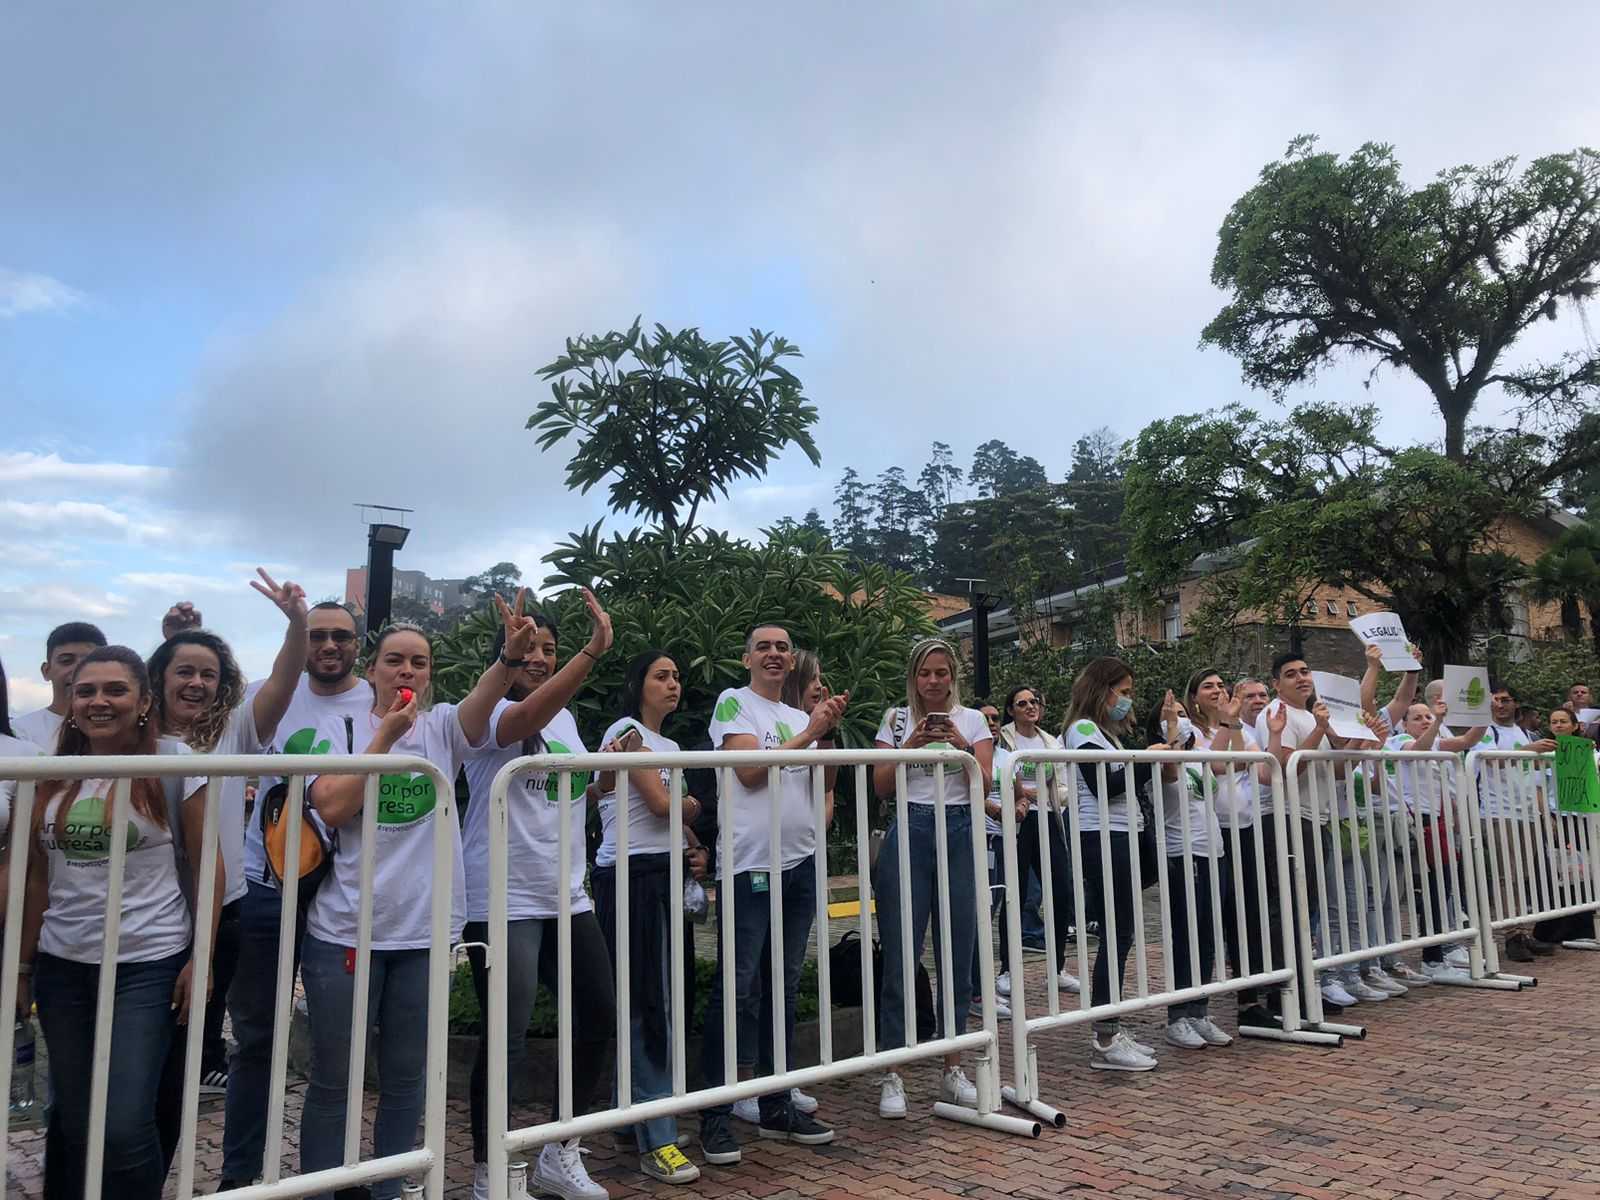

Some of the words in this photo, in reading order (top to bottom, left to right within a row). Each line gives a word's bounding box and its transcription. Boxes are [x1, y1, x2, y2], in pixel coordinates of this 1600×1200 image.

[380, 783, 398, 796] or
[400, 783, 430, 801] por
[378, 800, 415, 814] resa
